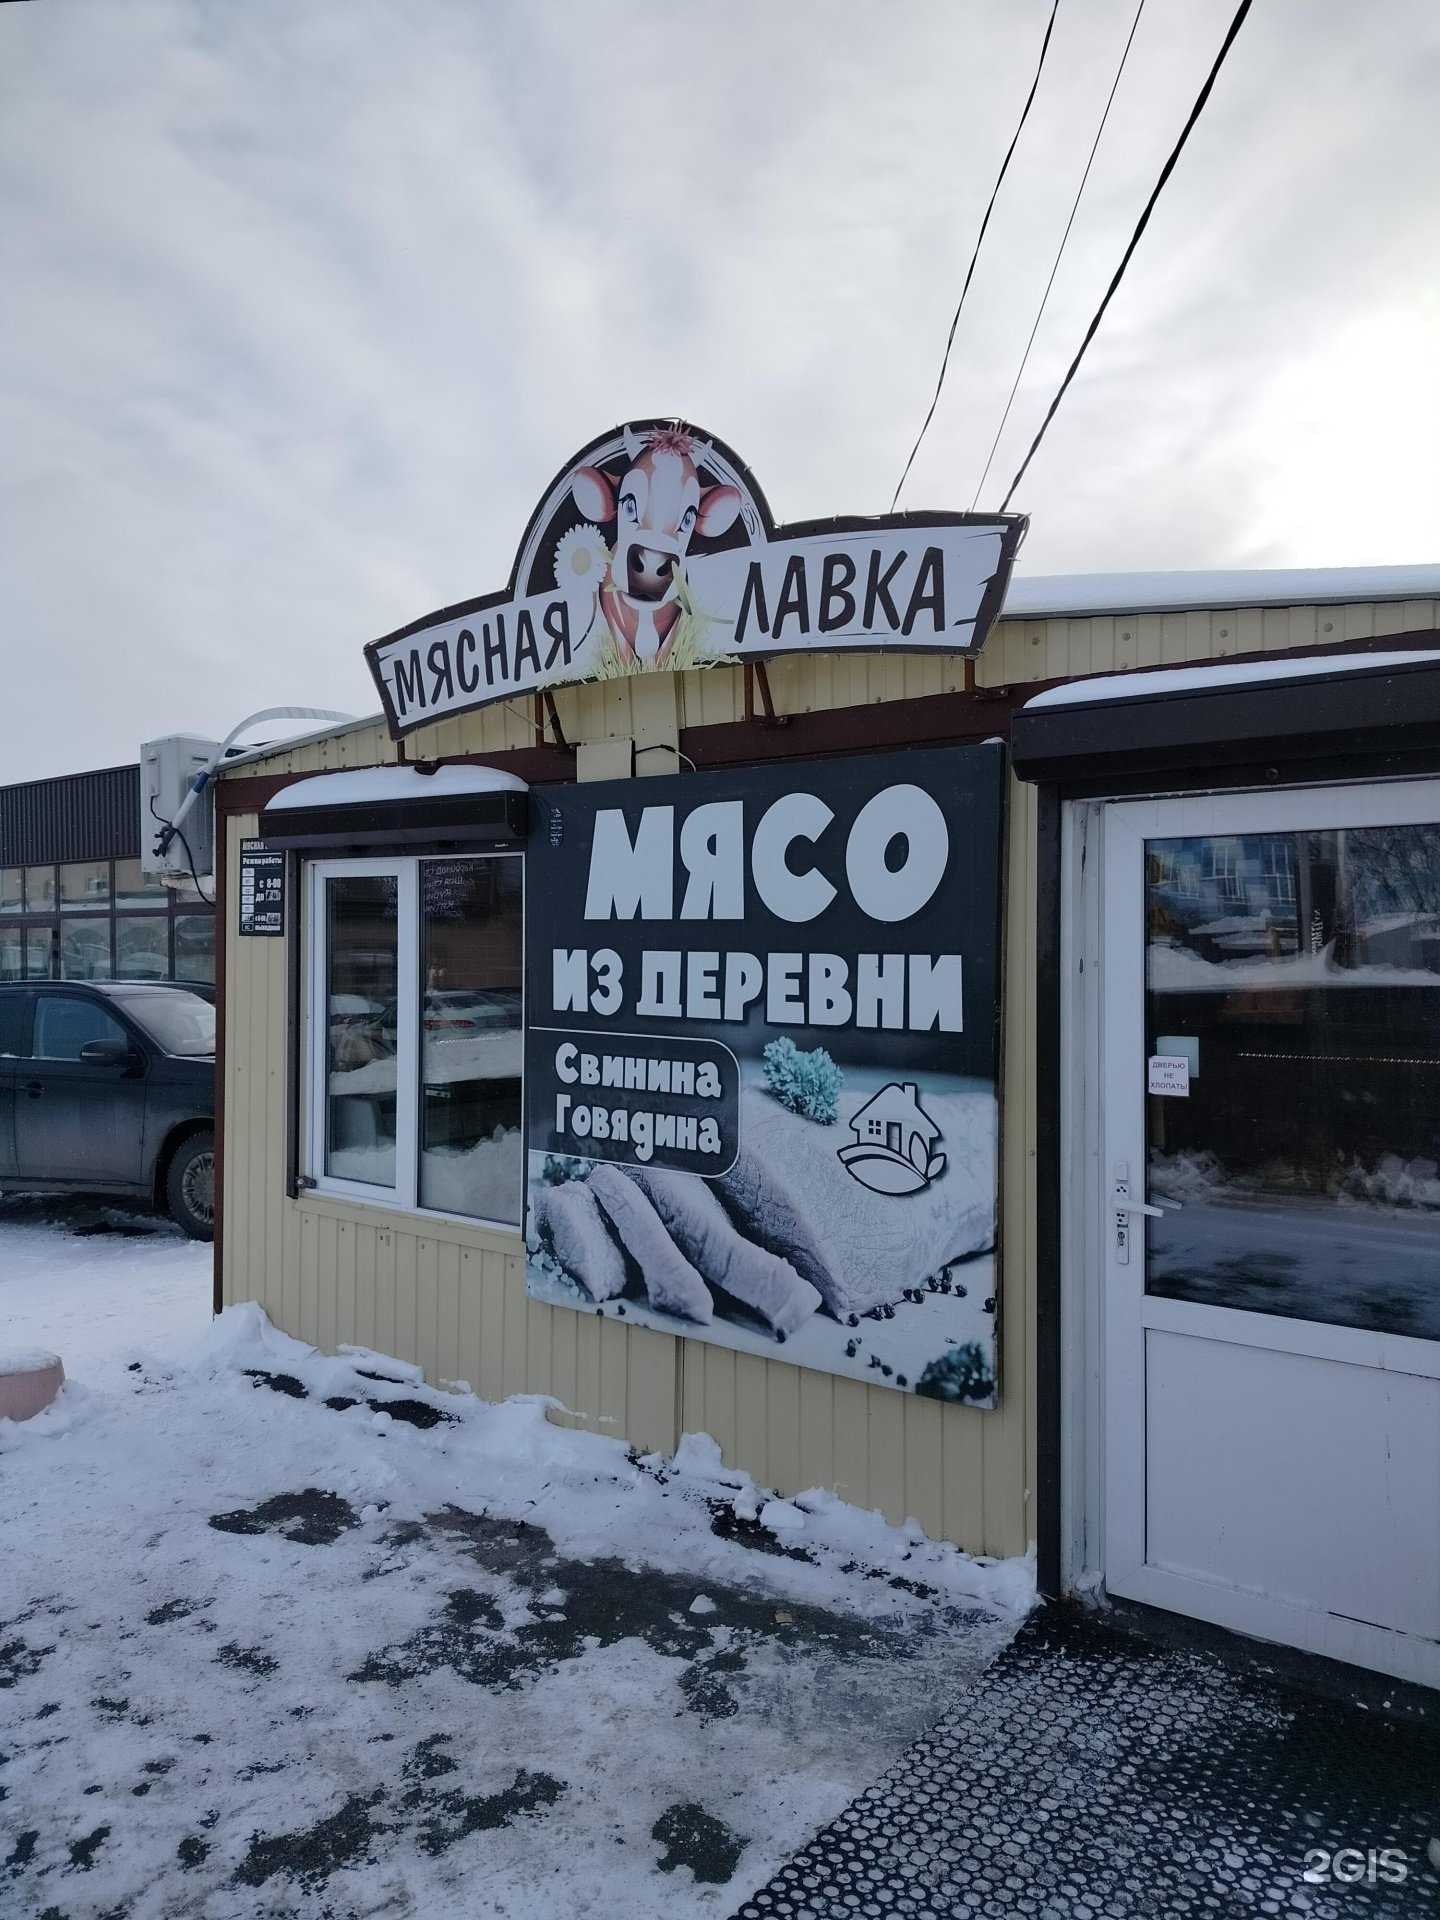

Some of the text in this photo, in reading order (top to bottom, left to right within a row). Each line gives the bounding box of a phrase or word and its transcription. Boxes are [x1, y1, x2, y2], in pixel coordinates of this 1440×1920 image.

[393, 547, 946, 717] МЯСНАЯ ЛАВКА
[584, 784, 949, 922] МЯСО
[553, 949, 963, 1032] ИЗ ДЕРЕВНИ
[555, 1042, 722, 1097] Свинина
[555, 1093, 722, 1162] Говядина
